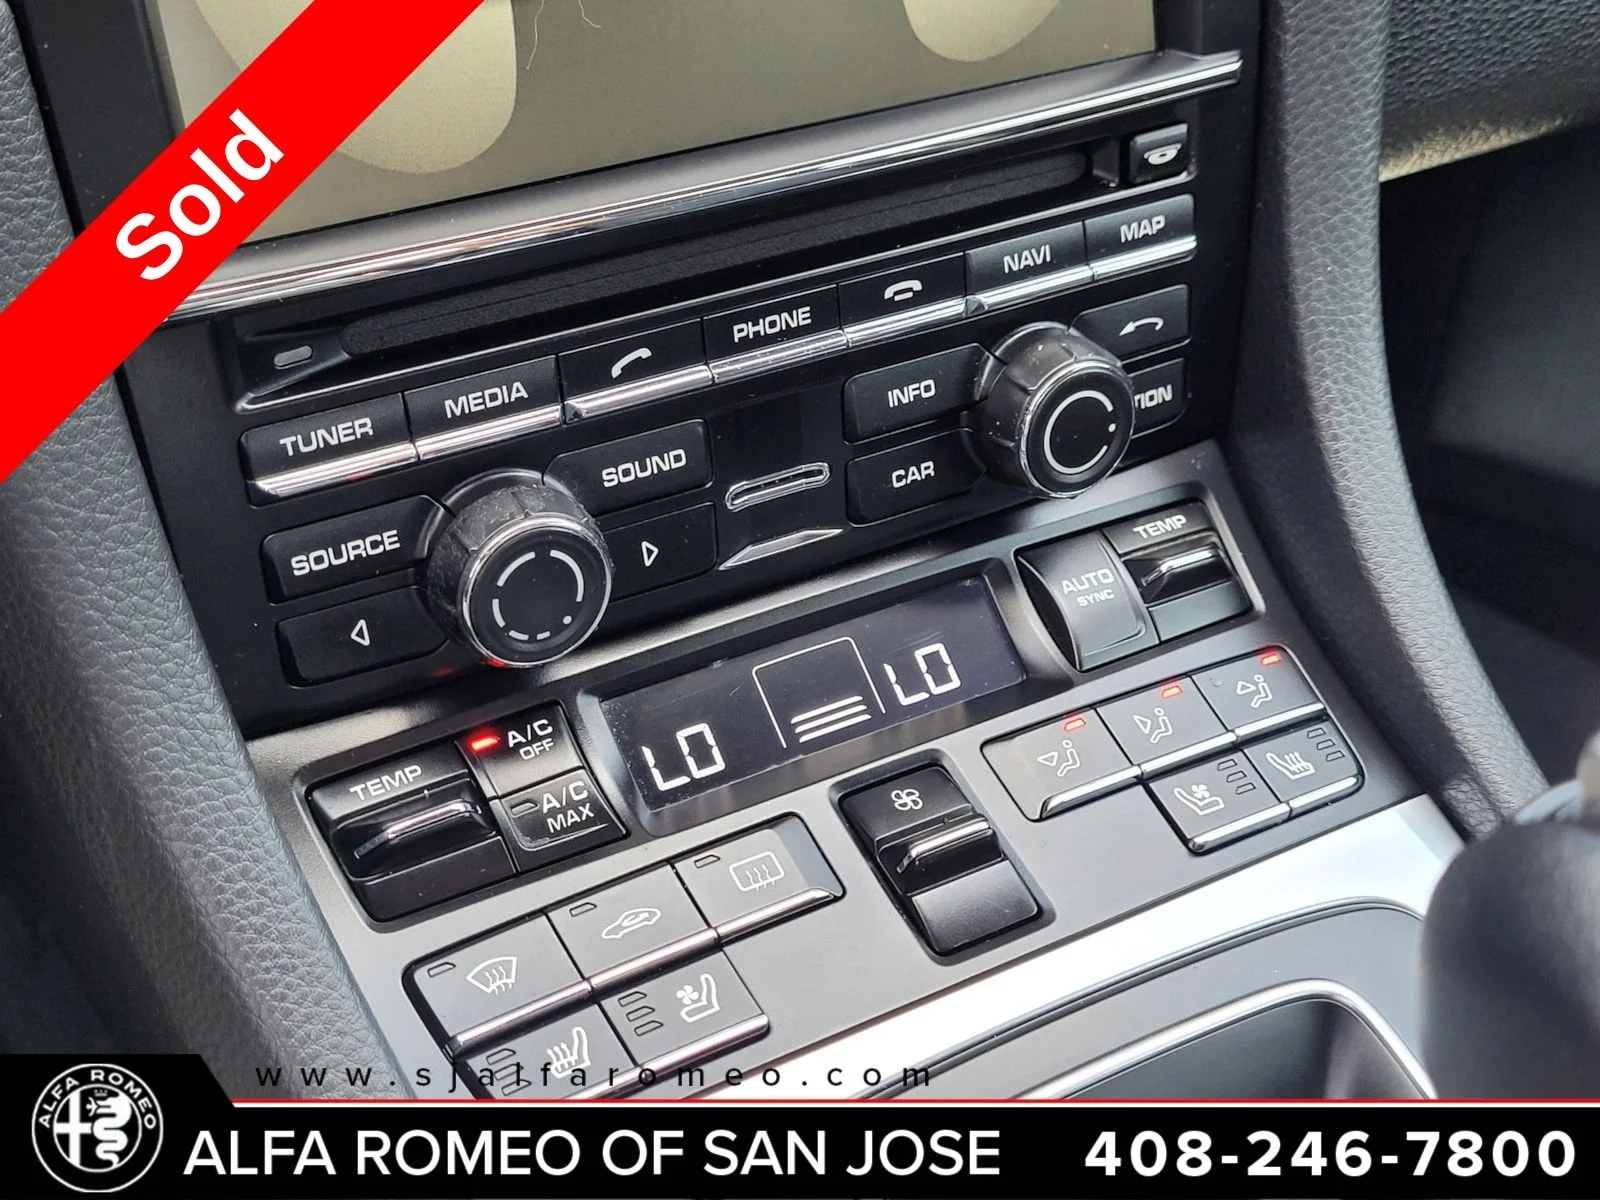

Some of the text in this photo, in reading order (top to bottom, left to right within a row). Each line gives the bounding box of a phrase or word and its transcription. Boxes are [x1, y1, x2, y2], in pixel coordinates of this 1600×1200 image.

[1119, 214, 1166, 243] MAP
[1003, 244, 1052, 274] NAVI
[733, 305, 812, 343] PHONE
[444, 381, 529, 418] MEDIA
[887, 378, 937, 408] INFO
[279, 417, 374, 457] TUNER
[601, 448, 688, 488] SOUND
[891, 461, 936, 489] CAR
[1132, 514, 1188, 540] TEMP
[291, 529, 401, 577] SOURCE
[1061, 567, 1115, 596] AUTO
[1076, 588, 1115, 608] SYNC
[884, 642, 961, 706] LO
[507, 718, 554, 748] A/C
[519, 737, 556, 762] OFF
[641, 722, 727, 793] LO
[349, 764, 423, 801] TEMP
[541, 780, 590, 814] A/C
[546, 802, 595, 834] MAX
